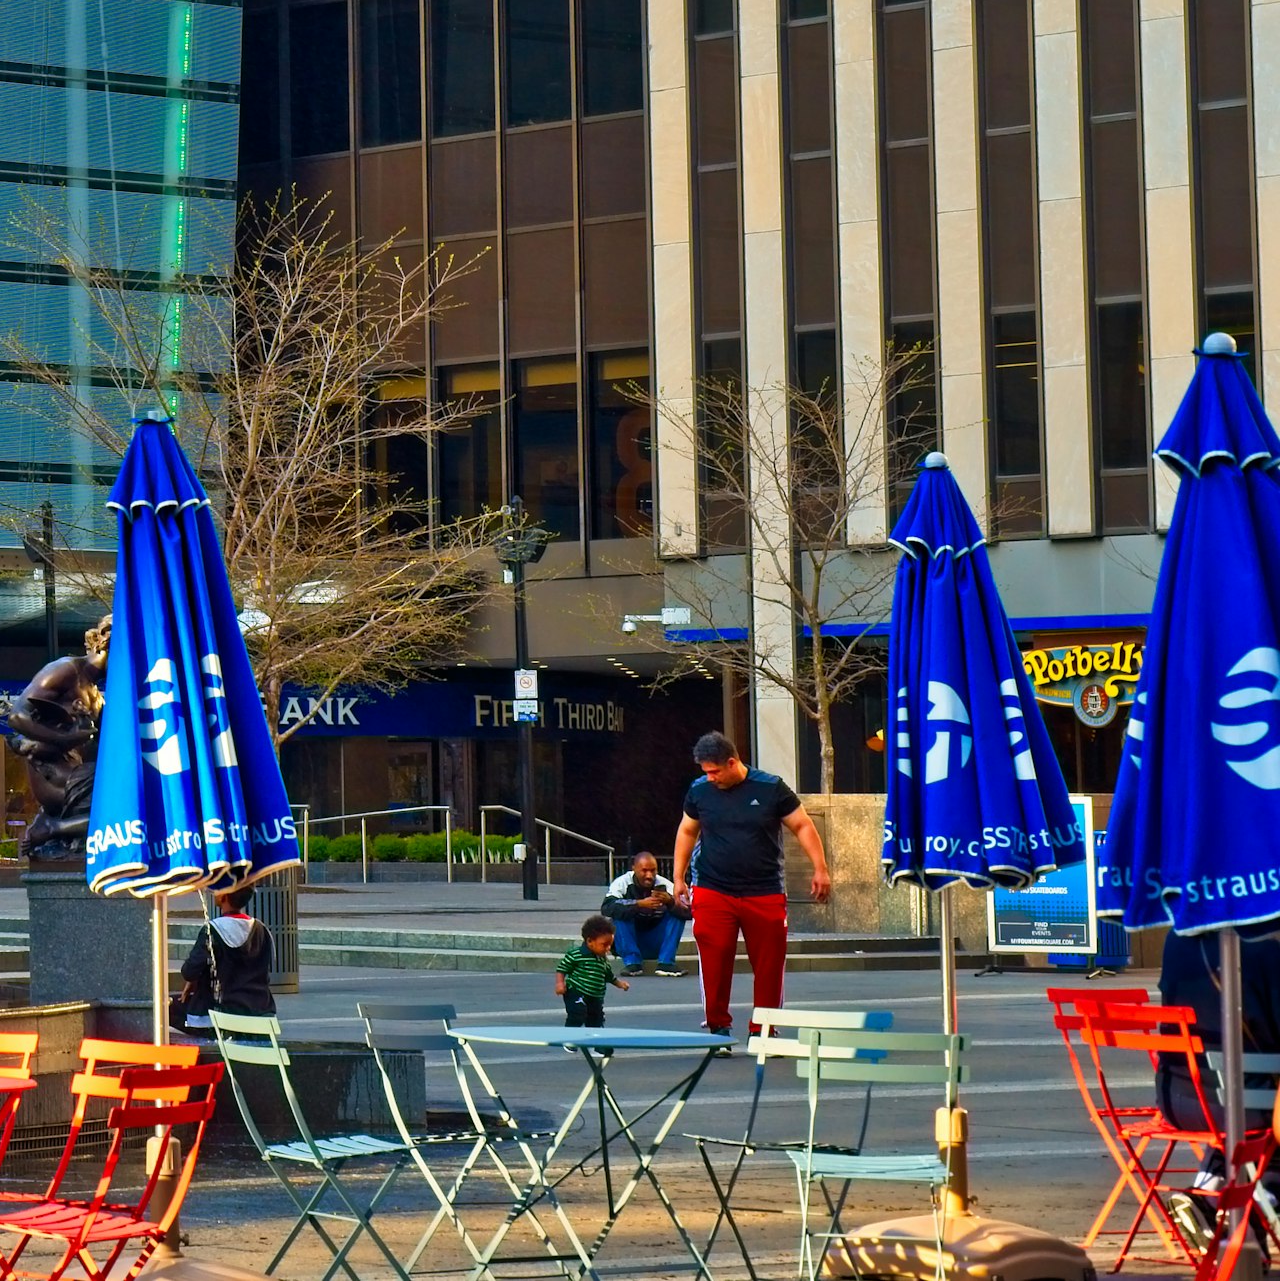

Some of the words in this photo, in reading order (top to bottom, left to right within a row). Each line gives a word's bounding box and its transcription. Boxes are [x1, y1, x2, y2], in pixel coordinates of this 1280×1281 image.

[473, 694, 546, 728] FIFH
[553, 697, 605, 731] THIRD
[1030, 886, 1069, 895] SKATEBOARDS
